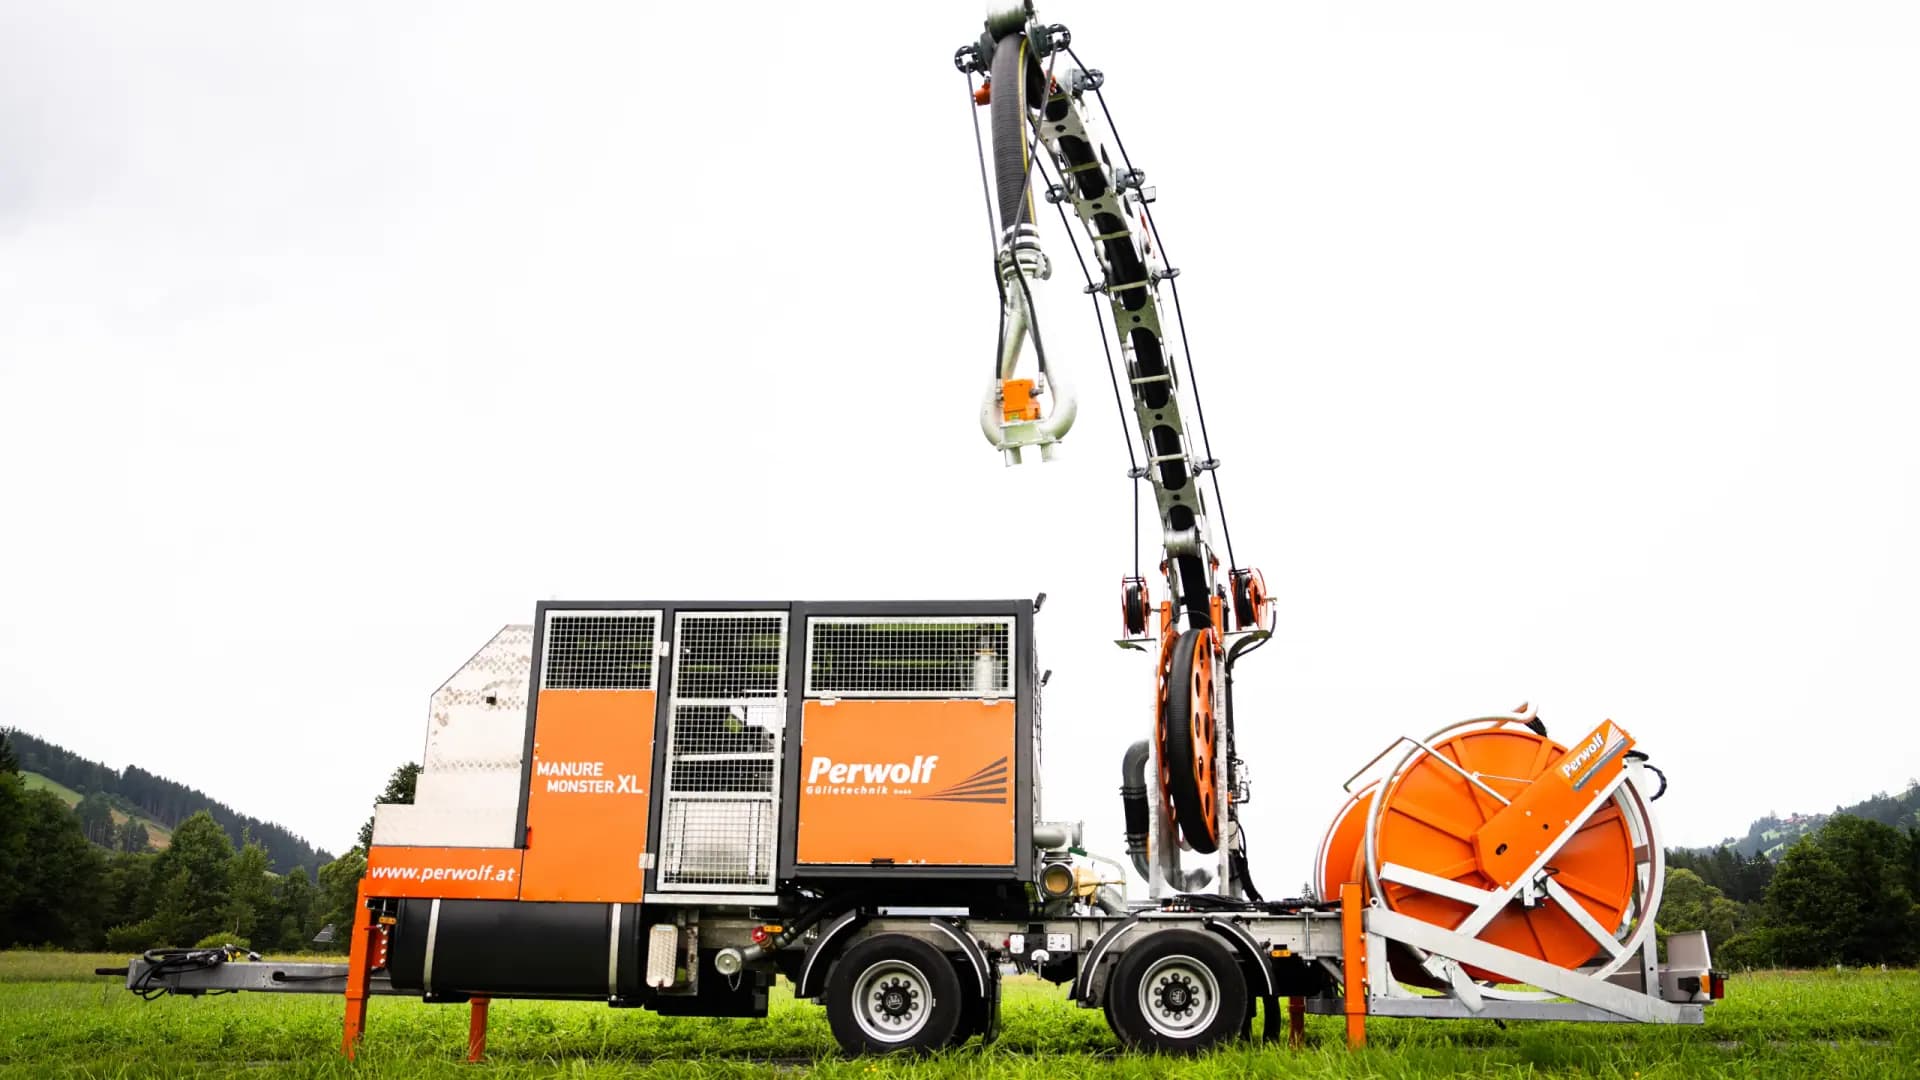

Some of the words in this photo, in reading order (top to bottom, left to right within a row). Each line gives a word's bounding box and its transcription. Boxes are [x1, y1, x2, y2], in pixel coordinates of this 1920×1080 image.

[1562, 732, 1606, 779] Perwolf
[537, 761, 605, 777] MANURE
[807, 755, 939, 784] Perwolf
[546, 779, 615, 793] MONSTER
[616, 774, 644, 794] XL
[805, 785, 889, 795] Gülletechnik
[371, 864, 516, 883] www.perwolf.at
